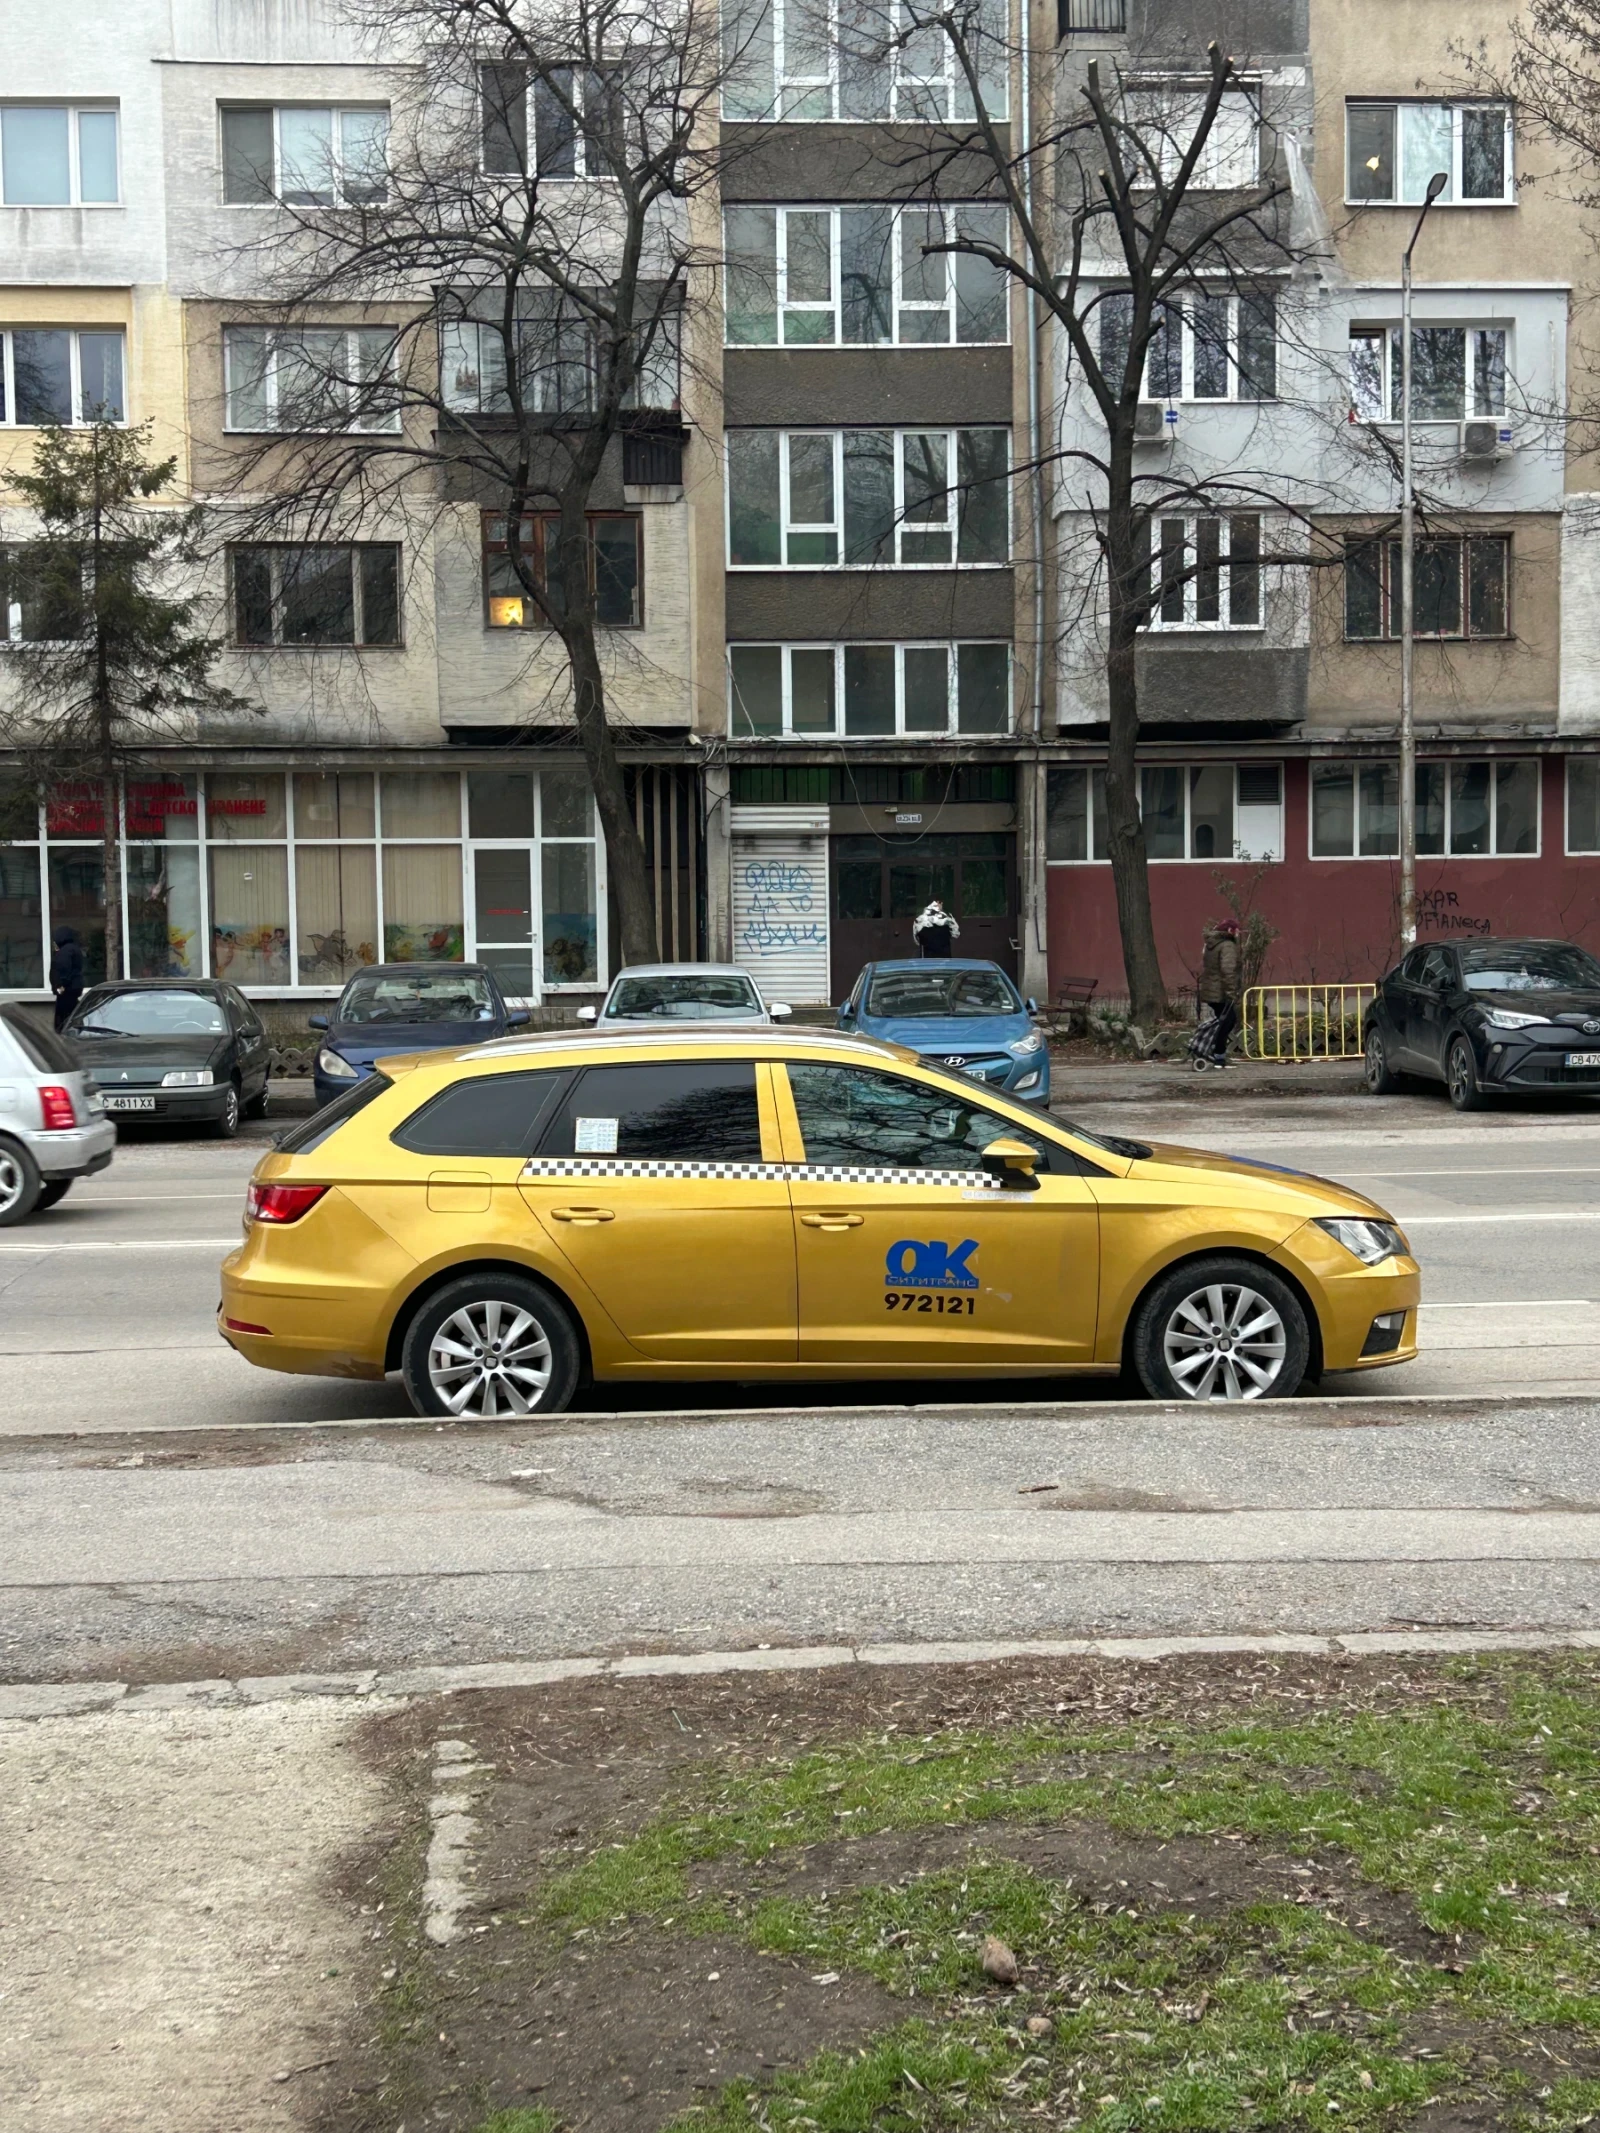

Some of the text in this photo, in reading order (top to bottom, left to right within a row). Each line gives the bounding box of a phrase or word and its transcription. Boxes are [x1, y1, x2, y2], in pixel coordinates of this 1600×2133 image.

[147, 800, 197, 815] ДЕТСКО
[113, 1098, 137, 1108] 4811
[140, 1098, 153, 1108] XX
[886, 1239, 979, 1279] OK
[884, 1293, 975, 1315] 972121
